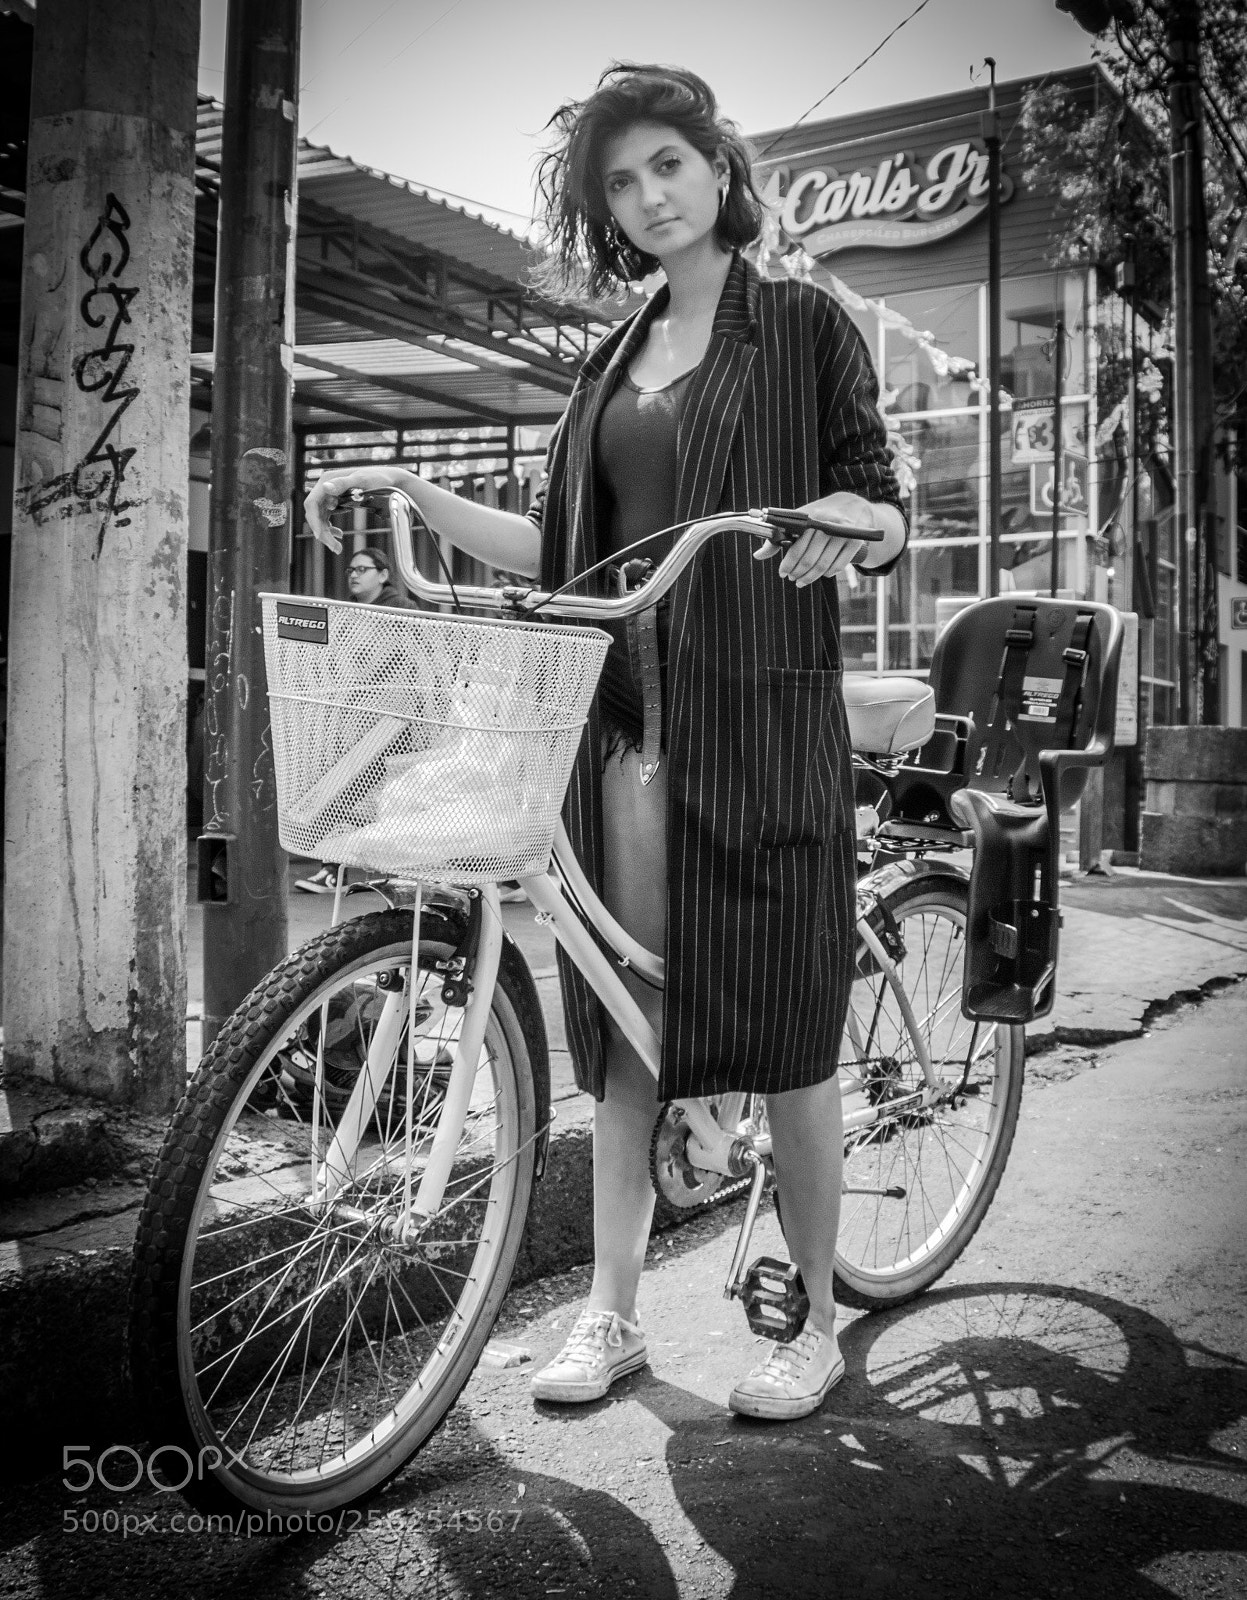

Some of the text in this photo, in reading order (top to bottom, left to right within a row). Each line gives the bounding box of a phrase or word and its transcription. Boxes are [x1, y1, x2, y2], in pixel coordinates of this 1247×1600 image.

[781, 142, 1001, 234] Carl's Jr
[902, 218, 959, 240] BURGERS
[278, 616, 326, 630] ALTREGO
